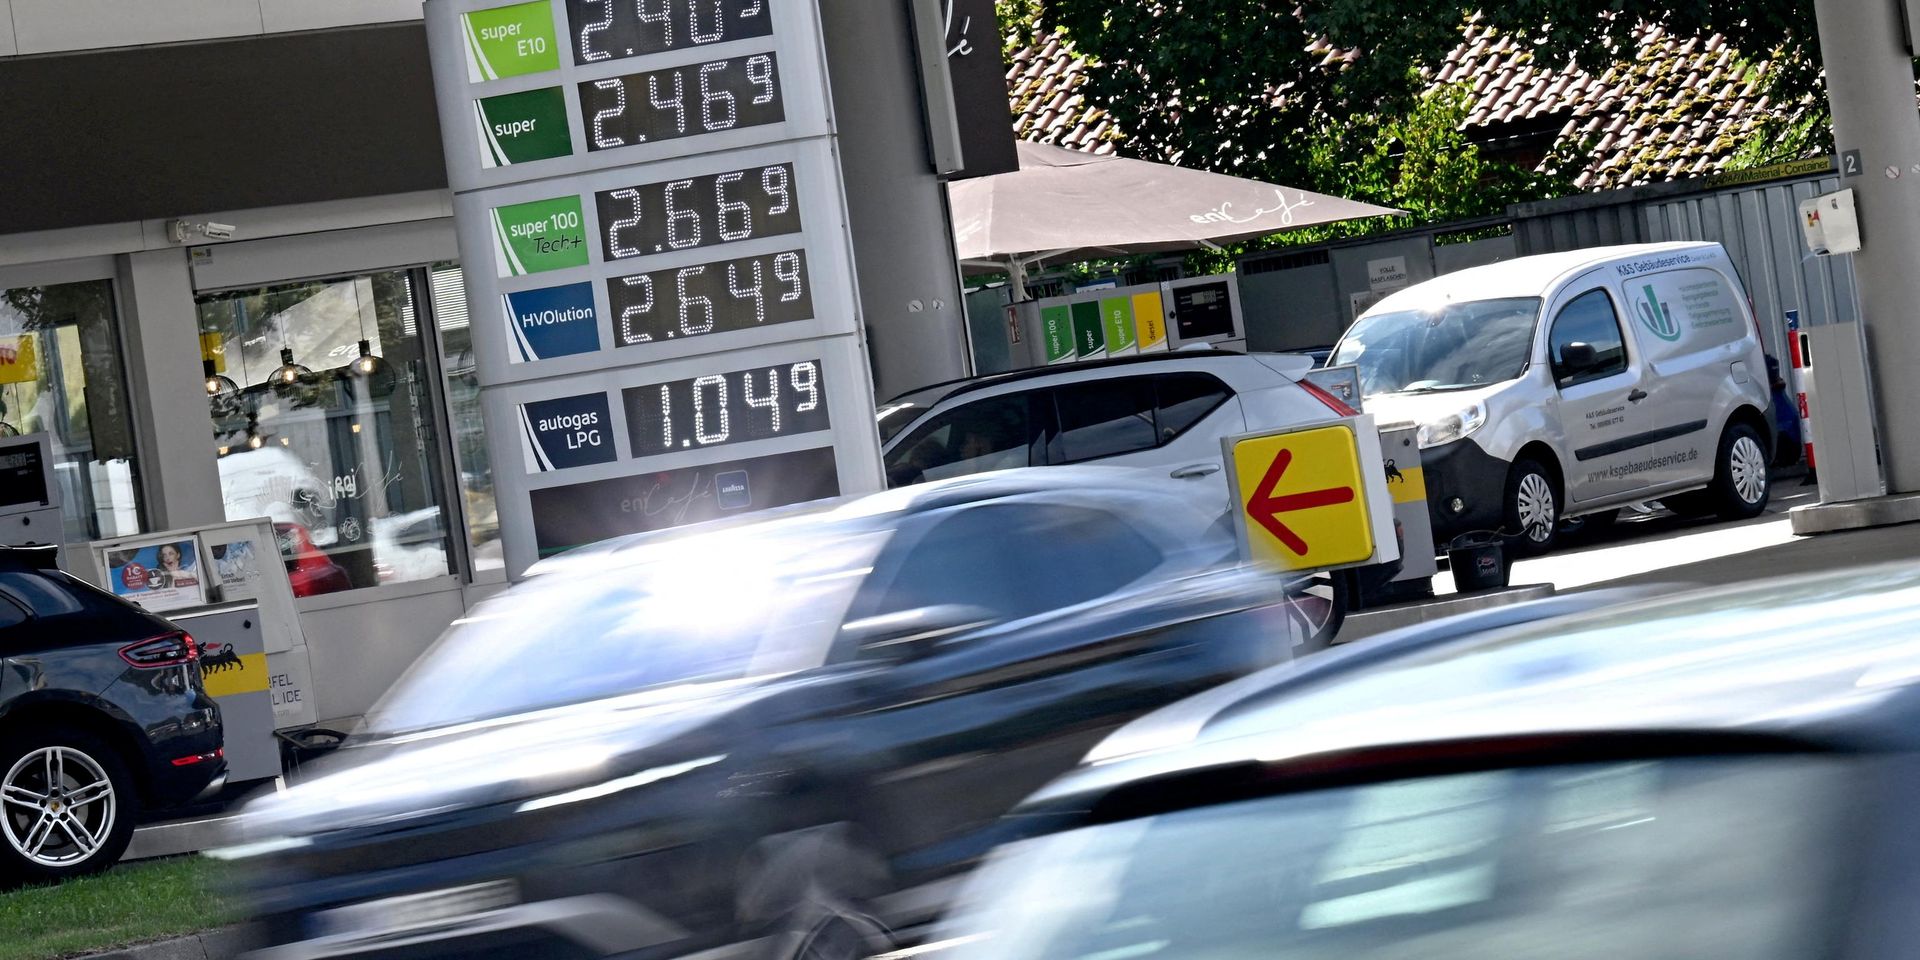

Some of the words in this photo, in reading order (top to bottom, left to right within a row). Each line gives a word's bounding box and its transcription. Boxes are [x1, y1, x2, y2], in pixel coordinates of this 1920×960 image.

[481, 21, 522, 41] super
[517, 37, 546, 56] E10
[495, 117, 537, 137] super
[1846, 155, 1857, 173] 2
[510, 219, 549, 238] super
[551, 212, 579, 230] 100
[533, 235, 583, 254] Tech+
[522, 306, 594, 328] HVOlution
[1048, 319, 1057, 334] 100
[1148, 320, 1156, 340] diesel
[1052, 334, 1060, 355] super
[539, 411, 599, 433] autogas
[567, 432, 601, 451] LPG
[268, 673, 293, 688] FEL
[282, 689, 302, 704] ICE
